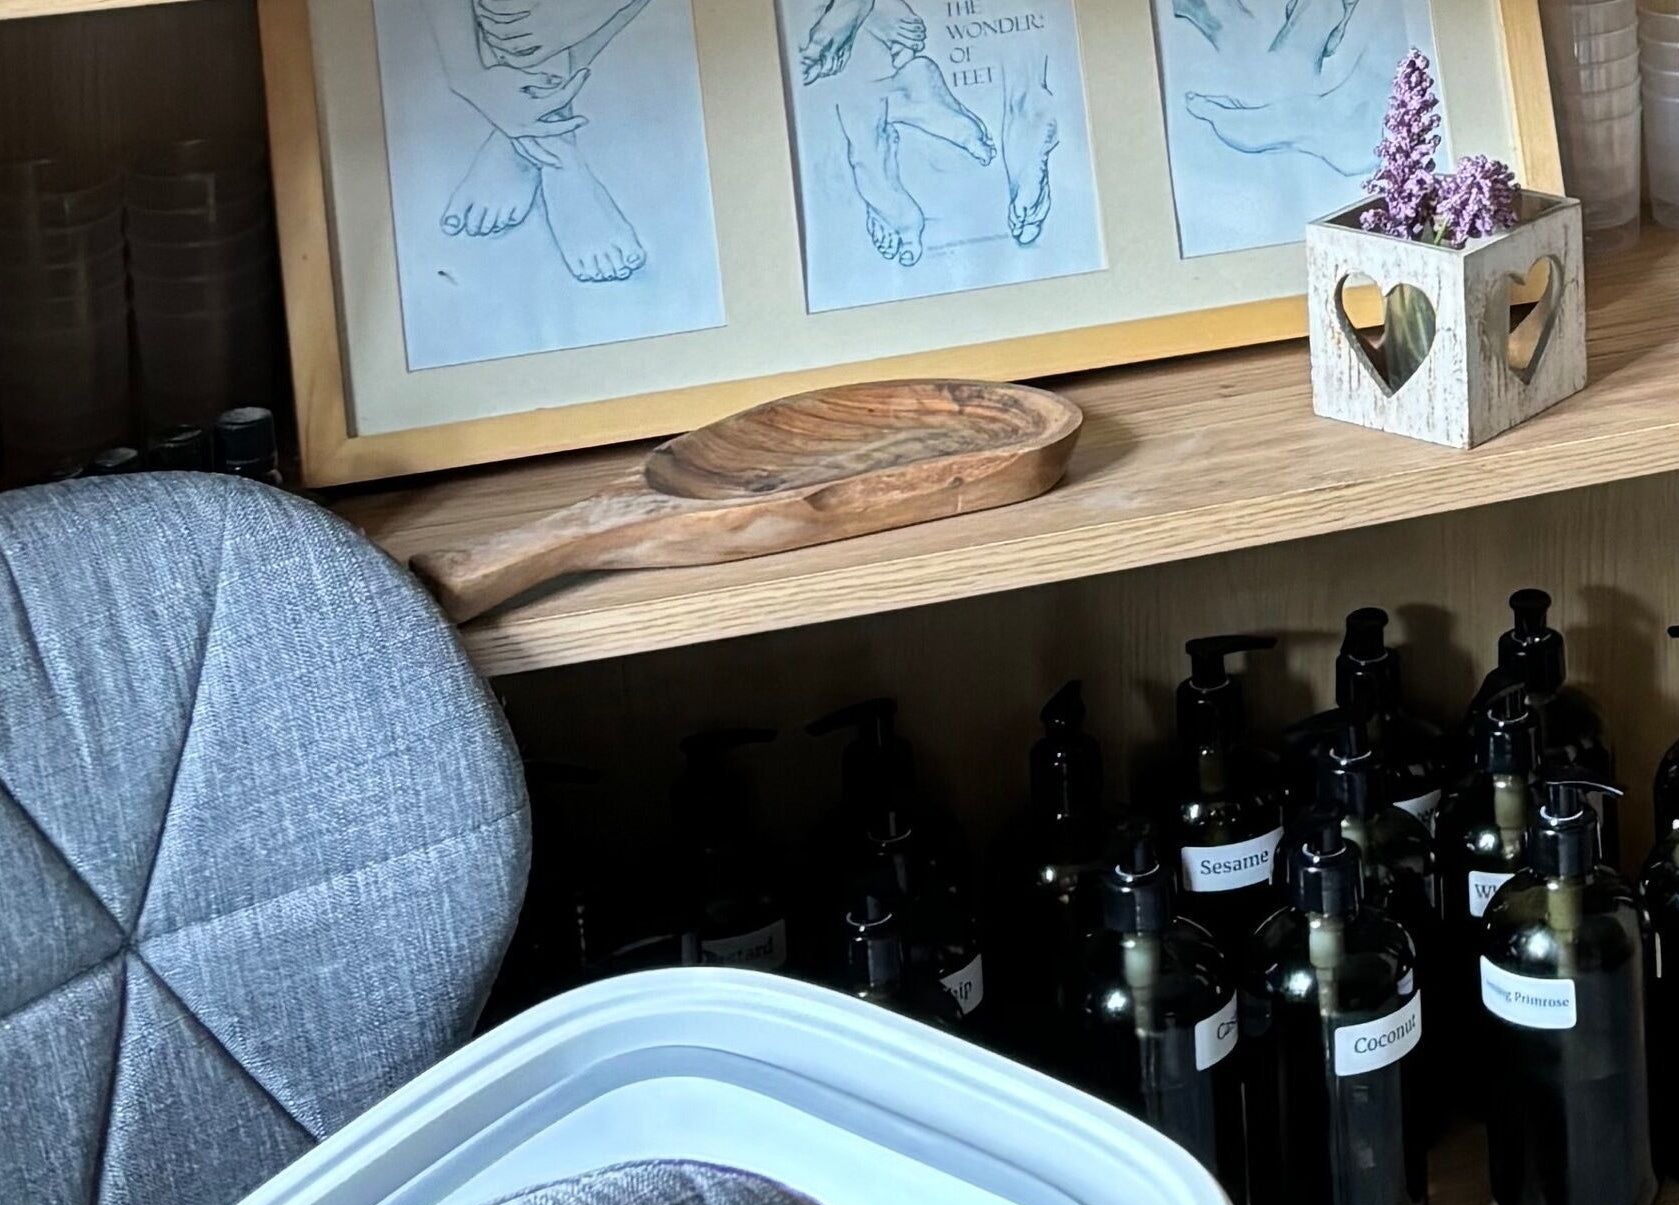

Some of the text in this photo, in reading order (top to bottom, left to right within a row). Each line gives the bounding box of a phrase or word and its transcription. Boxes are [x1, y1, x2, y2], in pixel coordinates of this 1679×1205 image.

[944, 0, 982, 17] THE
[949, 46, 974, 63] OF
[952, 66, 995, 87] FEET
[1200, 850, 1269, 875] Sesame
[1514, 991, 1570, 1007] Primrose
[1353, 1013, 1416, 1054] Coconut
